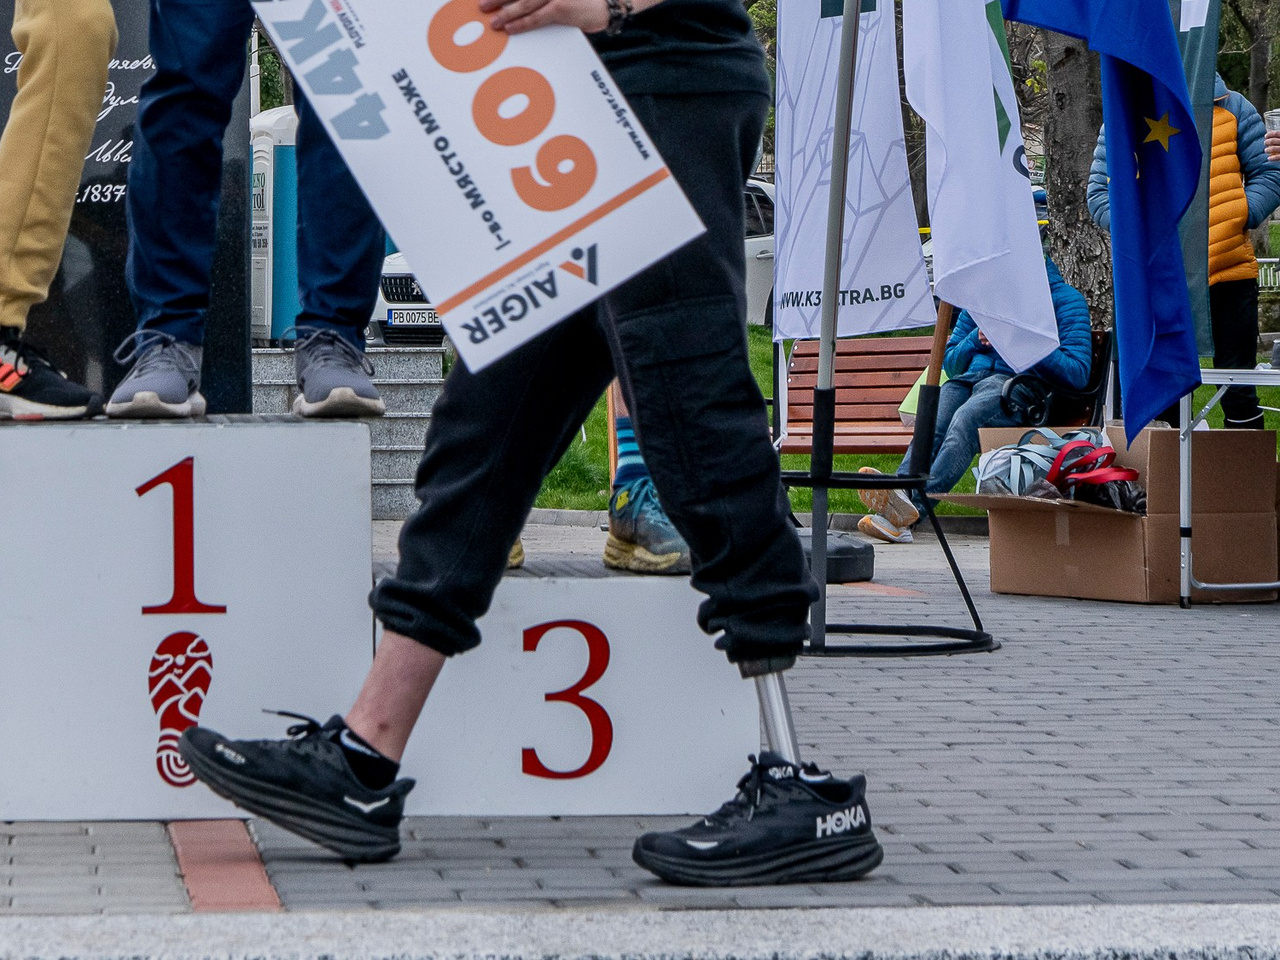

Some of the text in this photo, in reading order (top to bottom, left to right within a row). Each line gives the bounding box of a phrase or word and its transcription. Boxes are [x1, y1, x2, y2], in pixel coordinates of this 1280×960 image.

[391, 68, 441, 135] МЪЖЕ
[590, 69, 651, 161] www.aiger.com
[433, 136, 486, 210] МЯСТО
[393, 311, 405, 324] PB
[406, 311, 426, 324] 0075
[460, 269, 558, 344] AIGER
[134, 455, 227, 615] 1
[520, 618, 614, 780] 3
[816, 804, 867, 838] HOKA
